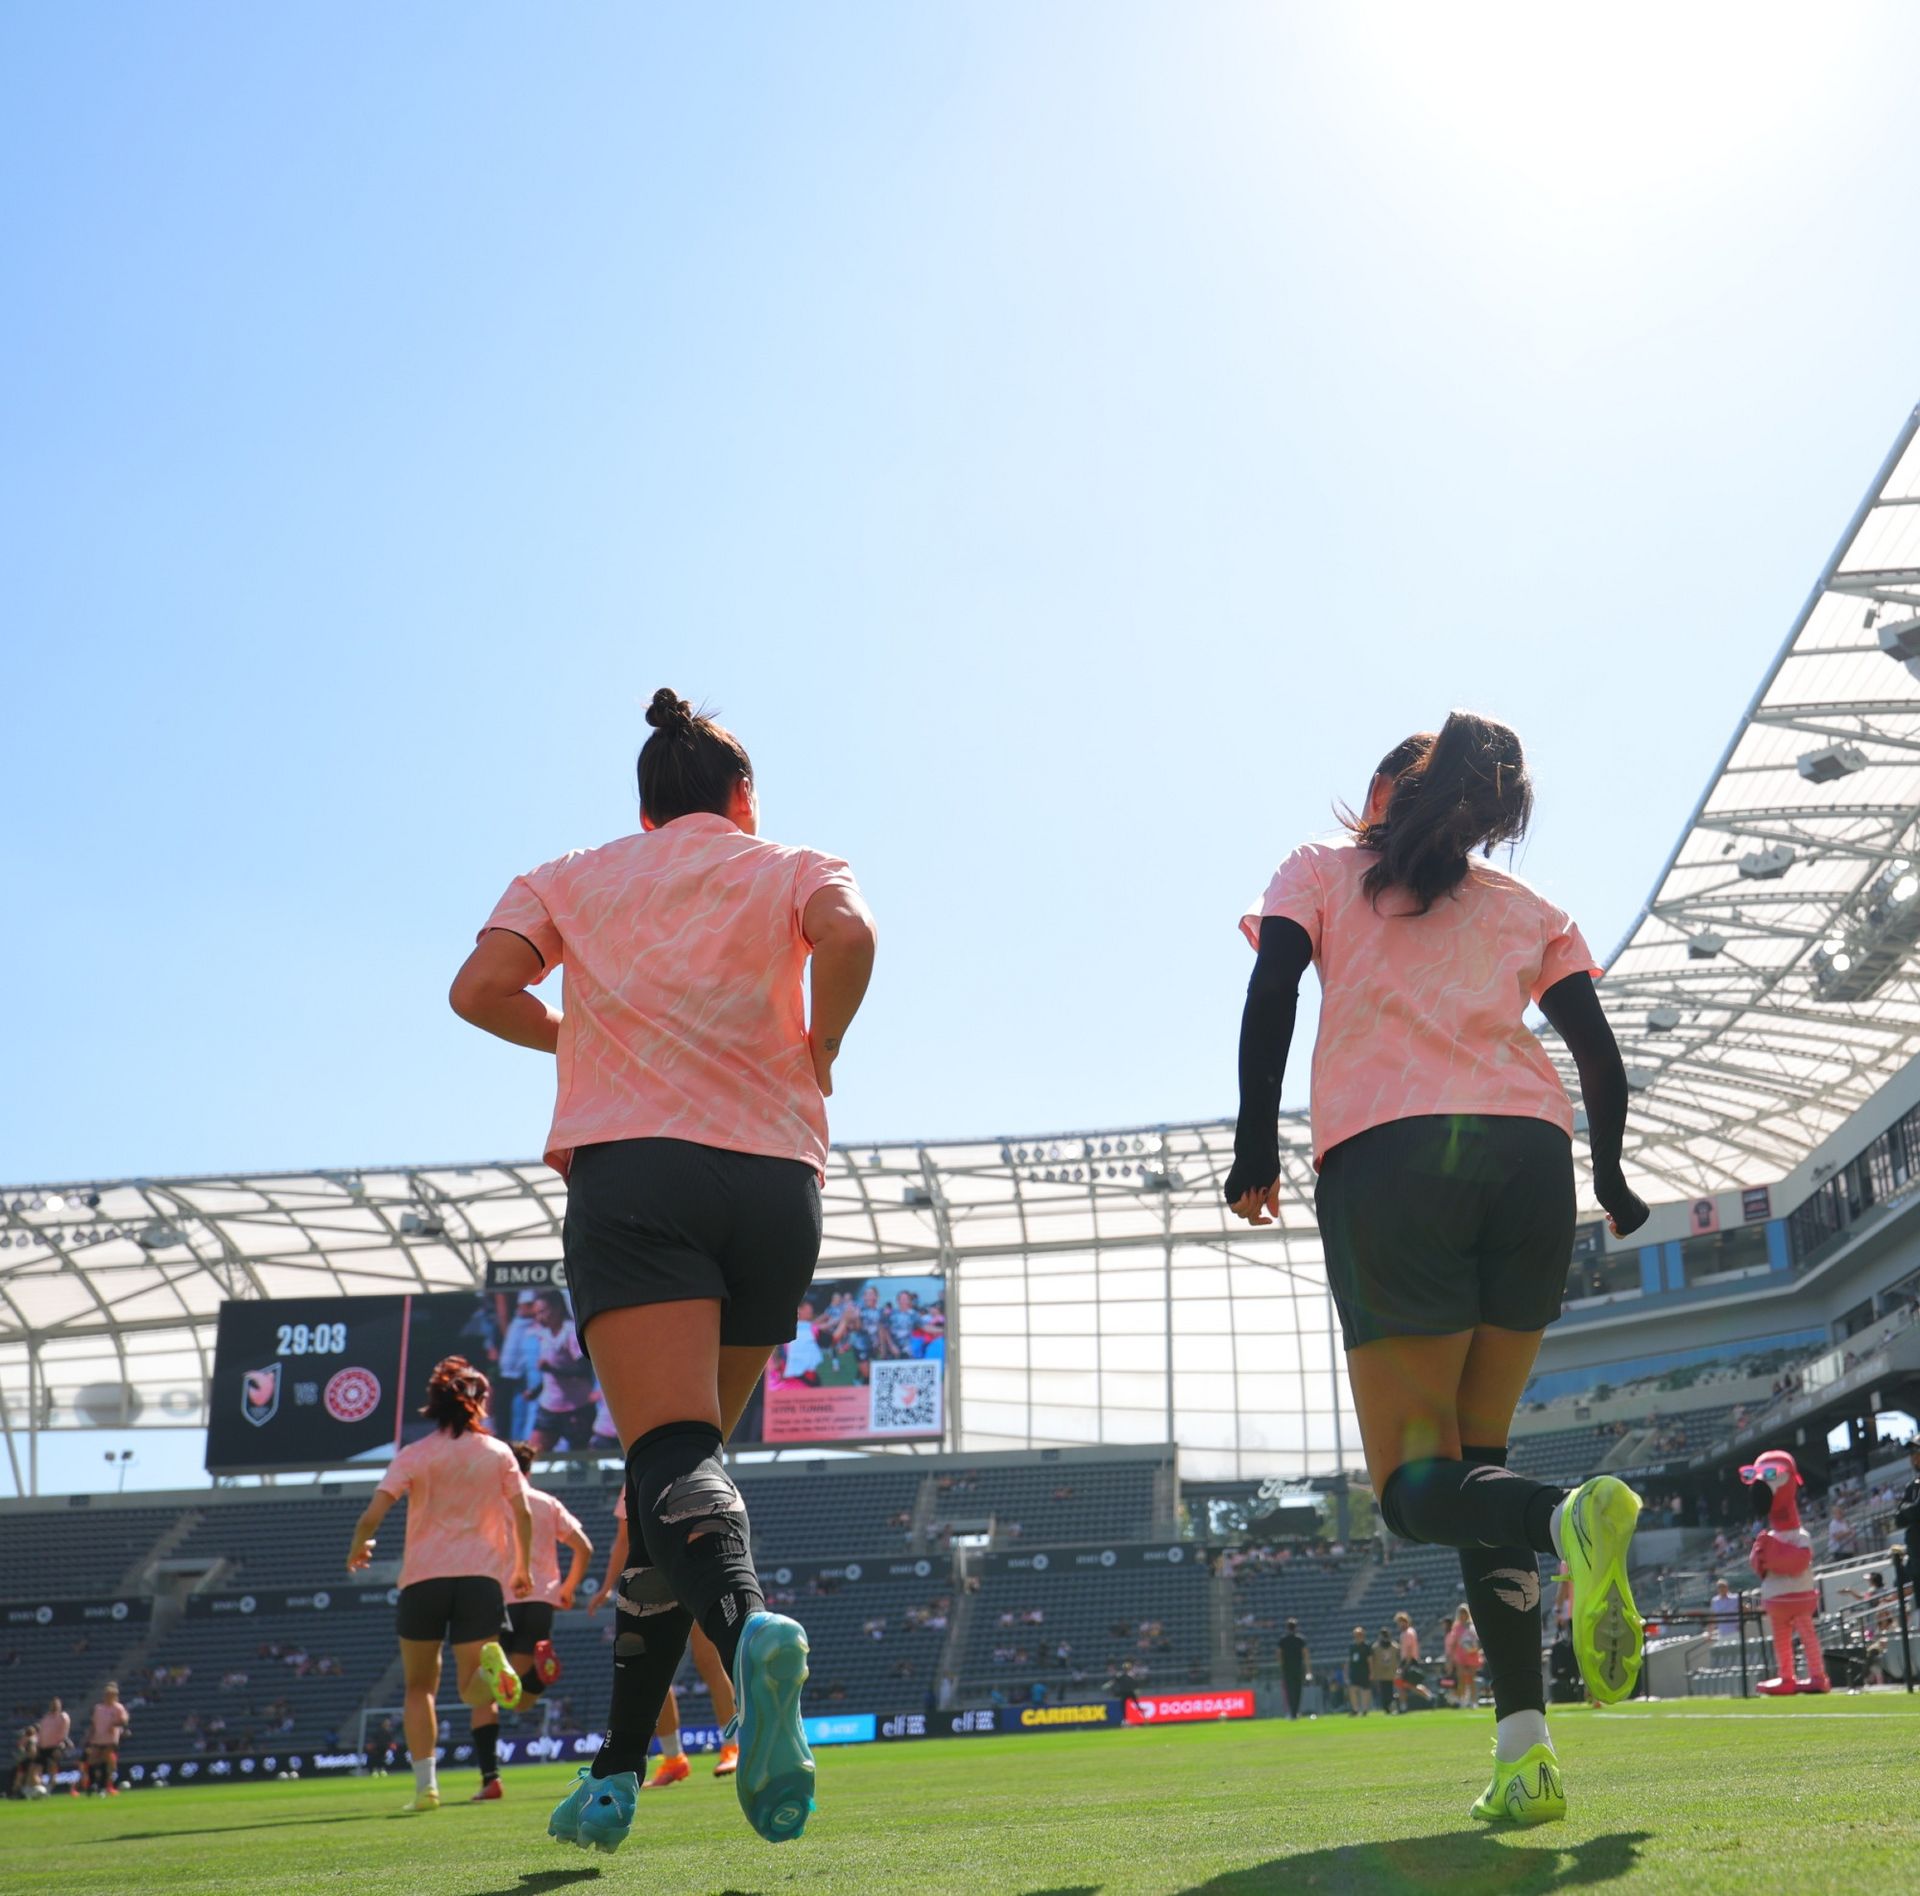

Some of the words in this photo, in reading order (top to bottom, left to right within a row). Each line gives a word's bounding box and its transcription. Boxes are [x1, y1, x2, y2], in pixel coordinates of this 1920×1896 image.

[494, 1265, 548, 1284] BMO
[276, 1322, 347, 1356] 29:03
[1257, 1475, 1314, 1500] Ford
[1159, 1698, 1245, 1715] DOORDASH
[526, 1736, 565, 1760] ally
